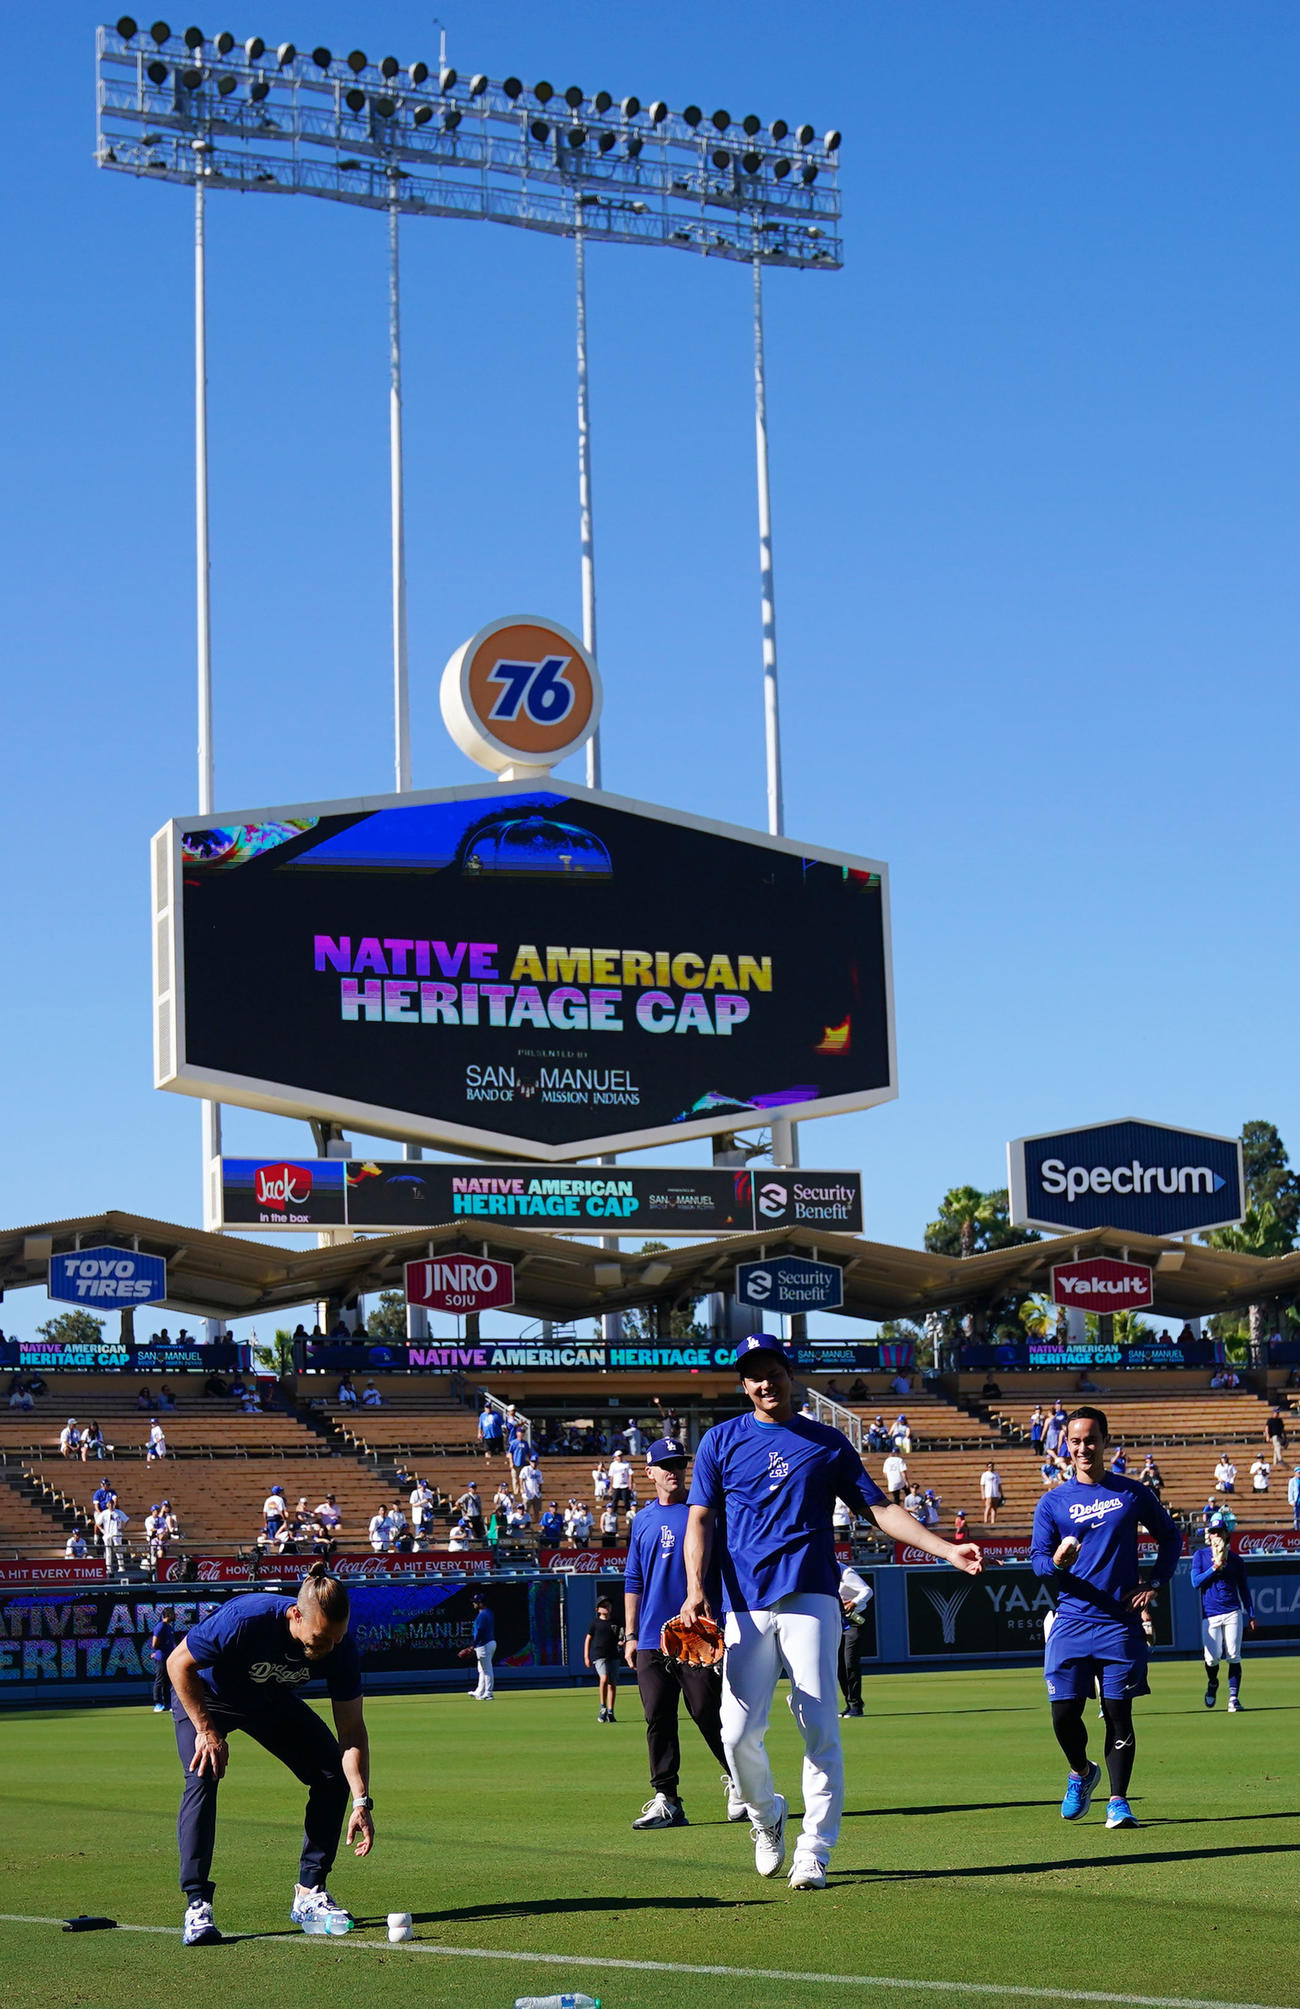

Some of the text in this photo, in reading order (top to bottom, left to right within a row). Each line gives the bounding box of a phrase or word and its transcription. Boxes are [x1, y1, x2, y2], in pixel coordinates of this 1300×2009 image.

[486, 655, 575, 726] 76
[314, 935, 773, 992] NATIVE AMERICAN
[341, 978, 750, 1035] HERITAGE CAP
[466, 1065, 639, 1091] SAN MANUEL
[466, 1088, 640, 1105] BAND OF MISSION INDIANS
[257, 1168, 310, 1203] Jack
[453, 1178, 633, 1196] NATIVE AMERICAN
[1041, 1159, 1215, 1202] Spectrum
[649, 1195, 714, 1205] SAN MANUEL
[794, 1184, 855, 1205] Security
[453, 1194, 639, 1217] HERITAGE CAP
[271, 1213, 286, 1222] the
[289, 1213, 310, 1223] box
[64, 1260, 135, 1278] TOYO
[423, 1264, 498, 1299] JINRO
[778, 1270, 833, 1288] Security
[1058, 1277, 1148, 1294] Yakult
[76, 1279, 152, 1297] TIRES
[779, 1286, 825, 1301] Benefit
[445, 1294, 476, 1307] SOJU
[20, 1344, 126, 1354] NATIVE AMERICAN
[747, 1336, 760, 1350] LA
[1029, 1345, 1118, 1353] NATIVE AMERICAN
[20, 1353, 130, 1366] HERITAGE CAP
[138, 1351, 202, 1361] SAN MANUEL
[409, 1349, 487, 1366] NATIVE
[491, 1349, 605, 1366] AMERICAN
[610, 1349, 710, 1365] HERITAGE
[714, 1348, 737, 1365] CA
[798, 1350, 855, 1358] SAN MANUEL
[1029, 1353, 1122, 1364] HERITAGE CAP
[1129, 1350, 1184, 1358] SAN MANUEL
[768, 1452, 789, 1478] LA
[1069, 1498, 1123, 1523] Dodgers
[660, 1525, 675, 1548] LA
[983, 1547, 1002, 1555] RUN
[394, 1563, 401, 1571] A
[404, 1561, 422, 1571] HIT
[425, 1561, 460, 1571] EVERY
[464, 1560, 491, 1570] TIME
[604, 1557, 627, 1565] HOM
[8, 1570, 29, 1579] HIT
[32, 1569, 71, 1579] EVERY
[74, 1568, 104, 1578] TIME
[226, 1566, 250, 1575] HOM
[285, 1565, 311, 1574] MAGI
[985, 1584, 1056, 1612] YAA
[357, 1621, 474, 1640] SAN MANUE
[1008, 1620, 1043, 1629] RESO
[248, 1662, 310, 1683] Dodgers
